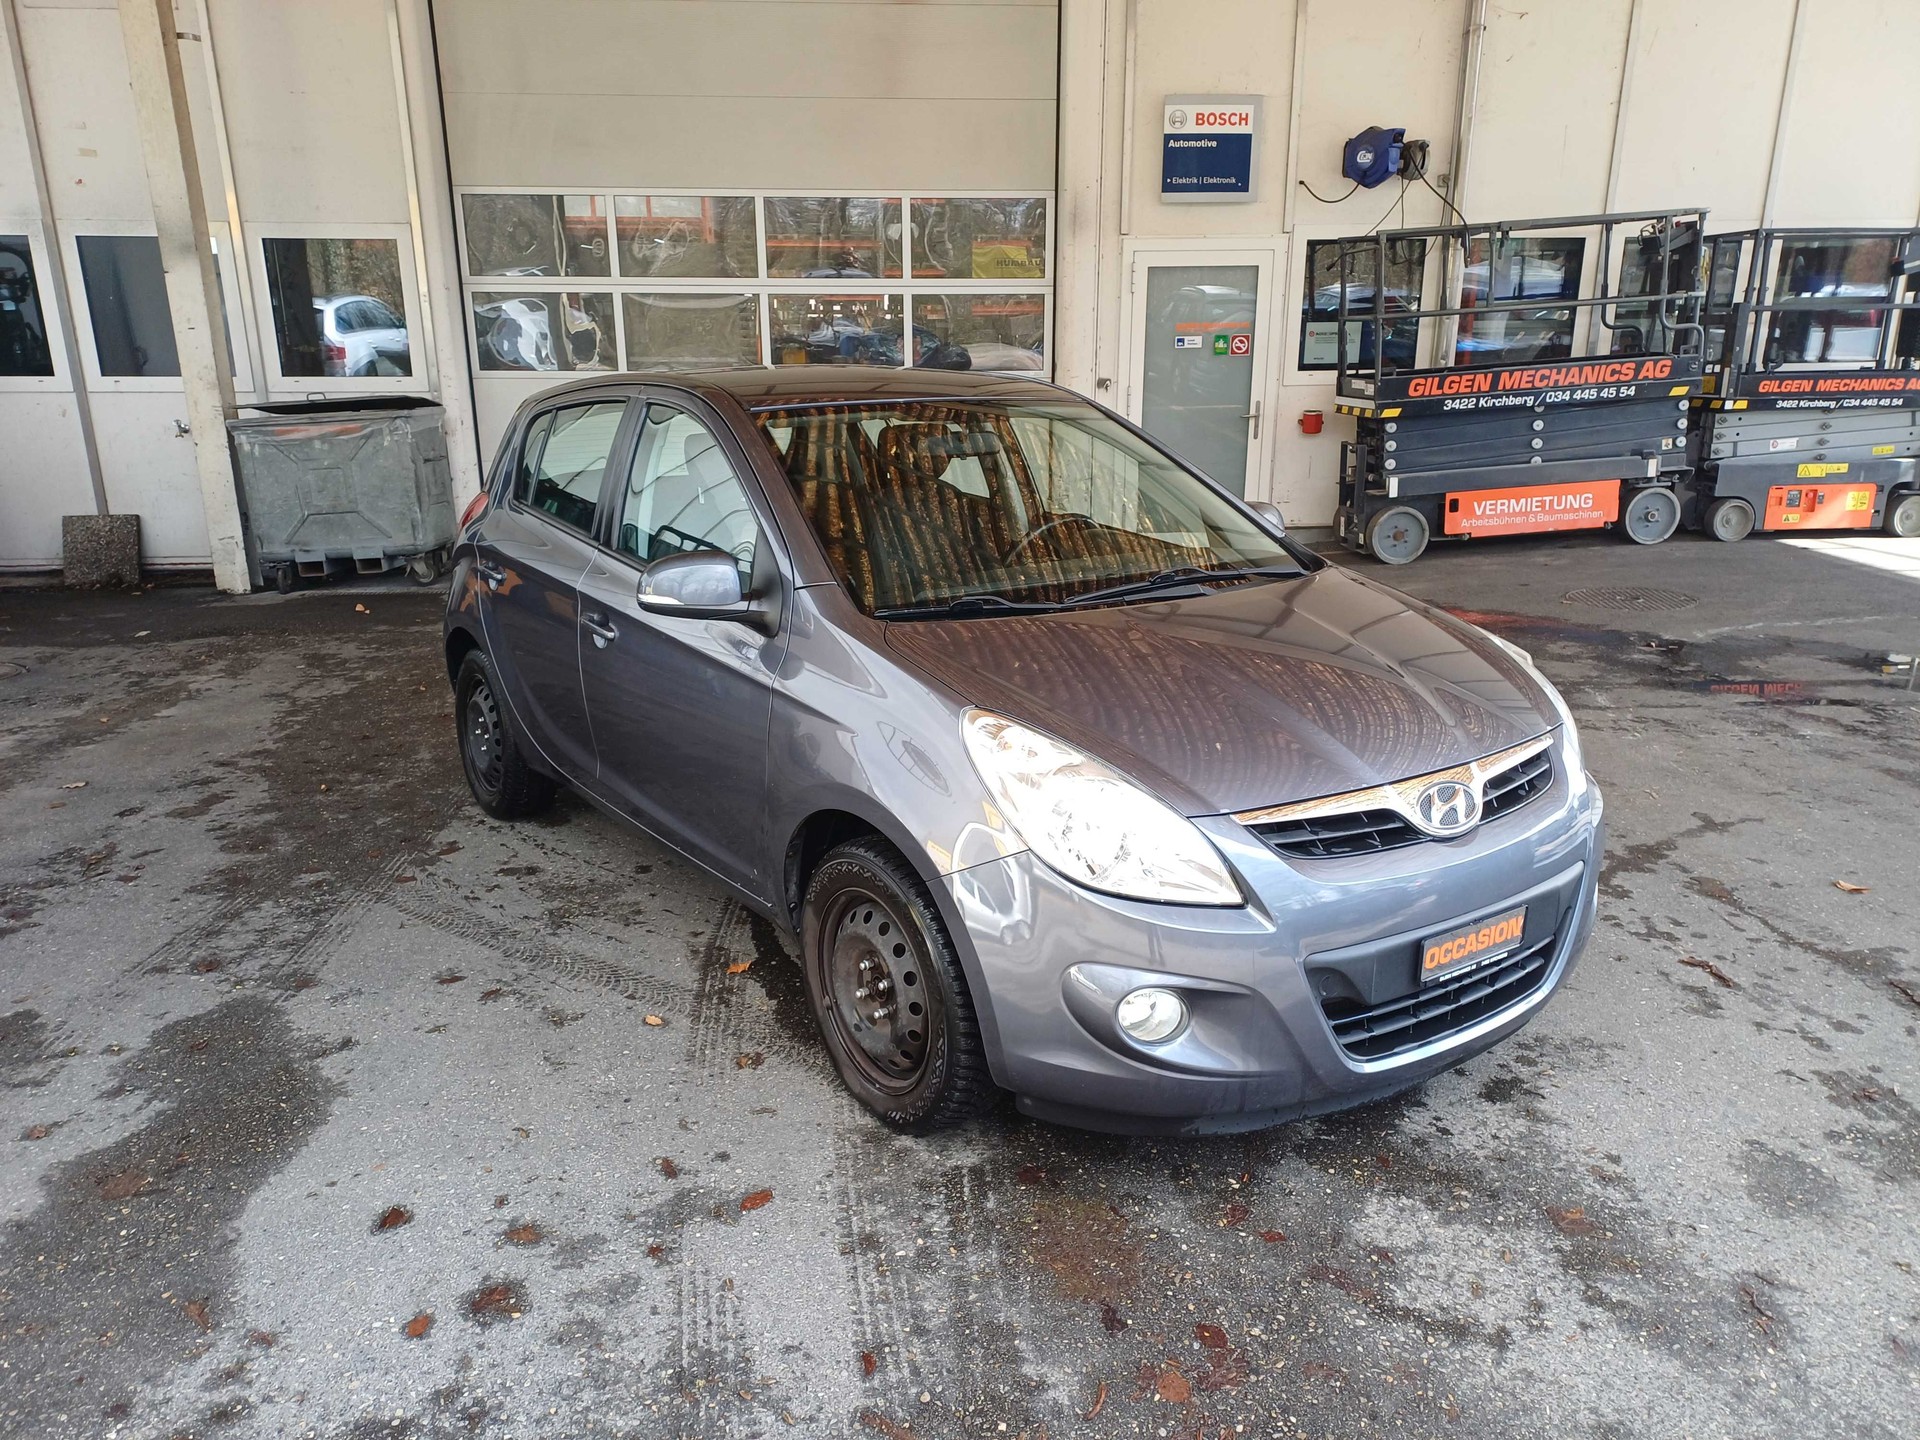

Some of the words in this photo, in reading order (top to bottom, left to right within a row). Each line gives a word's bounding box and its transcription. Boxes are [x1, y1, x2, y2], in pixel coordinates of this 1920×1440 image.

[1195, 112, 1249, 126] BOSCH
[1168, 139, 1217, 148] Automotive
[1203, 176, 1237, 184] Elektronik
[1408, 373, 1493, 397] GILGEN
[1498, 362, 1636, 391] MECHANICS
[1638, 359, 1672, 380] AG
[1758, 380, 1813, 393] GILGEN
[1816, 377, 1905, 392] MECHANICS
[1905, 378, 1920, 390] A
[1443, 398, 1476, 410] 3422
[1479, 395, 1534, 406] Kirchberg
[1573, 388, 1597, 400] 445
[1600, 387, 1617, 398] 45
[1619, 386, 1636, 397] 54
[1776, 400, 1798, 408] 3422
[1799, 399, 1836, 409] Kirchberg
[1861, 398, 1878, 406] 445
[1879, 398, 1891, 406] 45
[1891, 398, 1904, 406] 54
[1473, 493, 1593, 515] VERMIETUNG
[1461, 514, 1526, 527] Arbeitsbühnen
[1528, 514, 1536, 523] &
[1537, 510, 1603, 522] Baumaschinen
[1424, 915, 1525, 970] OCCASION
